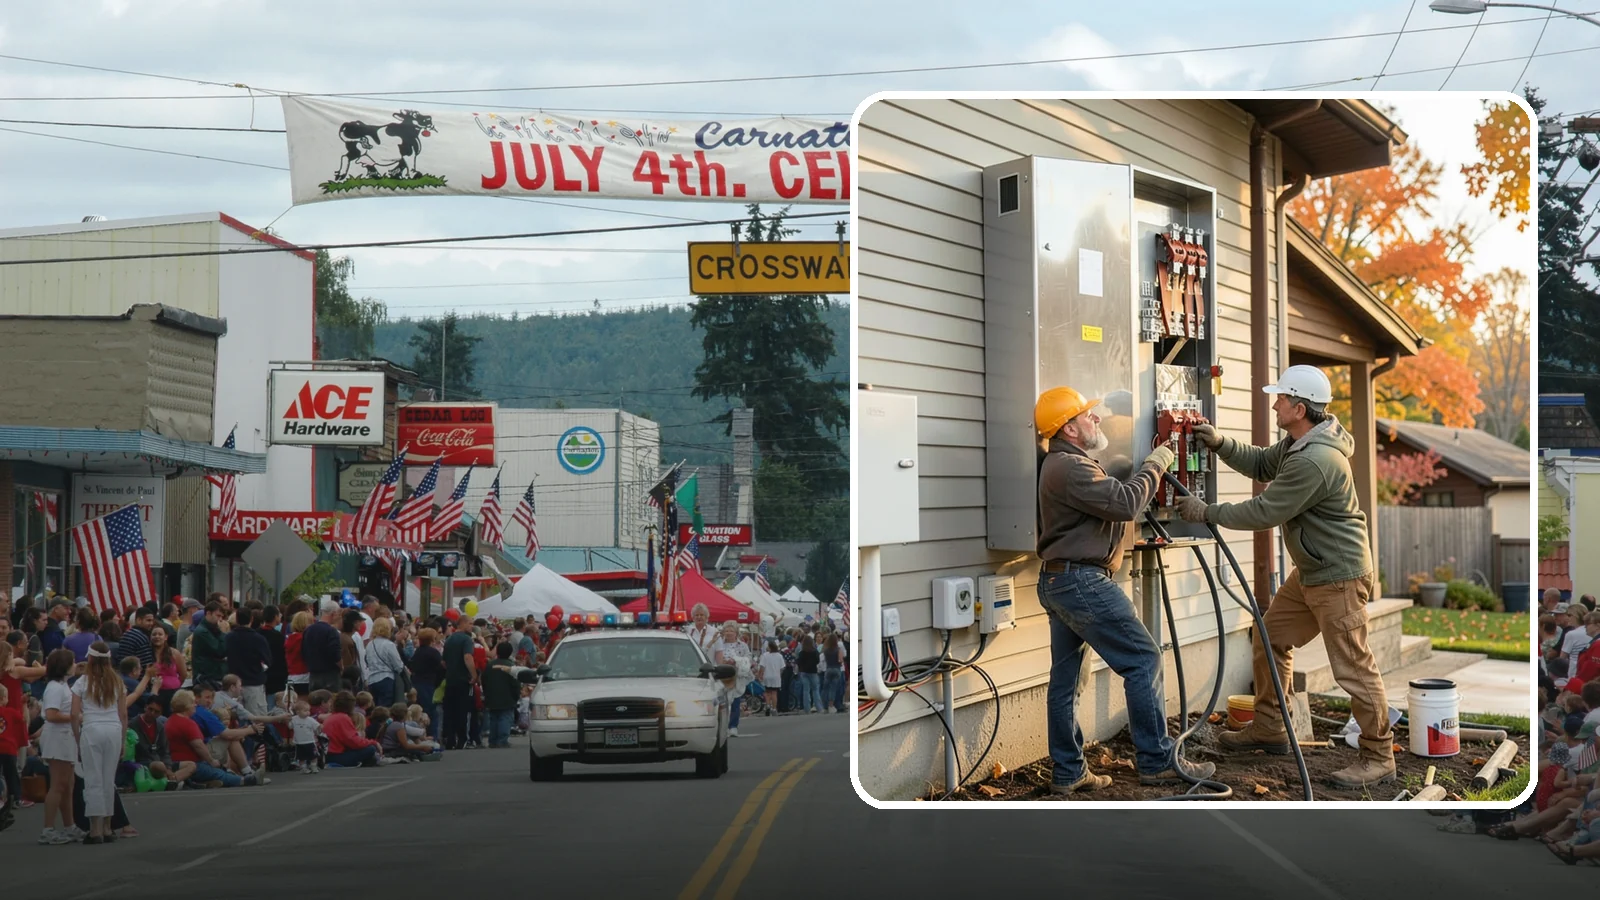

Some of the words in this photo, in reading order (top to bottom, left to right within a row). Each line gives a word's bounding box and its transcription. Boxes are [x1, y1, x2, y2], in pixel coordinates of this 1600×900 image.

[481, 141, 605, 193] JULY
[632, 149, 746, 198] 4th.
[697, 254, 850, 280] CROSSWA
[282, 380, 374, 420] ACE
[405, 409, 452, 422] CEDAR
[283, 421, 371, 436] Hardware
[416, 428, 477, 447] Coca-Cola
[83, 485, 93, 494] St.
[96, 485, 124, 495] Vincent
[126, 486, 135, 495] de
[138, 486, 155, 495] Paul
[81, 503, 153, 522] THT
[213, 515, 331, 535] HARDARE
[688, 526, 741, 535] CRNATION
[699, 535, 730, 543] GLASS
